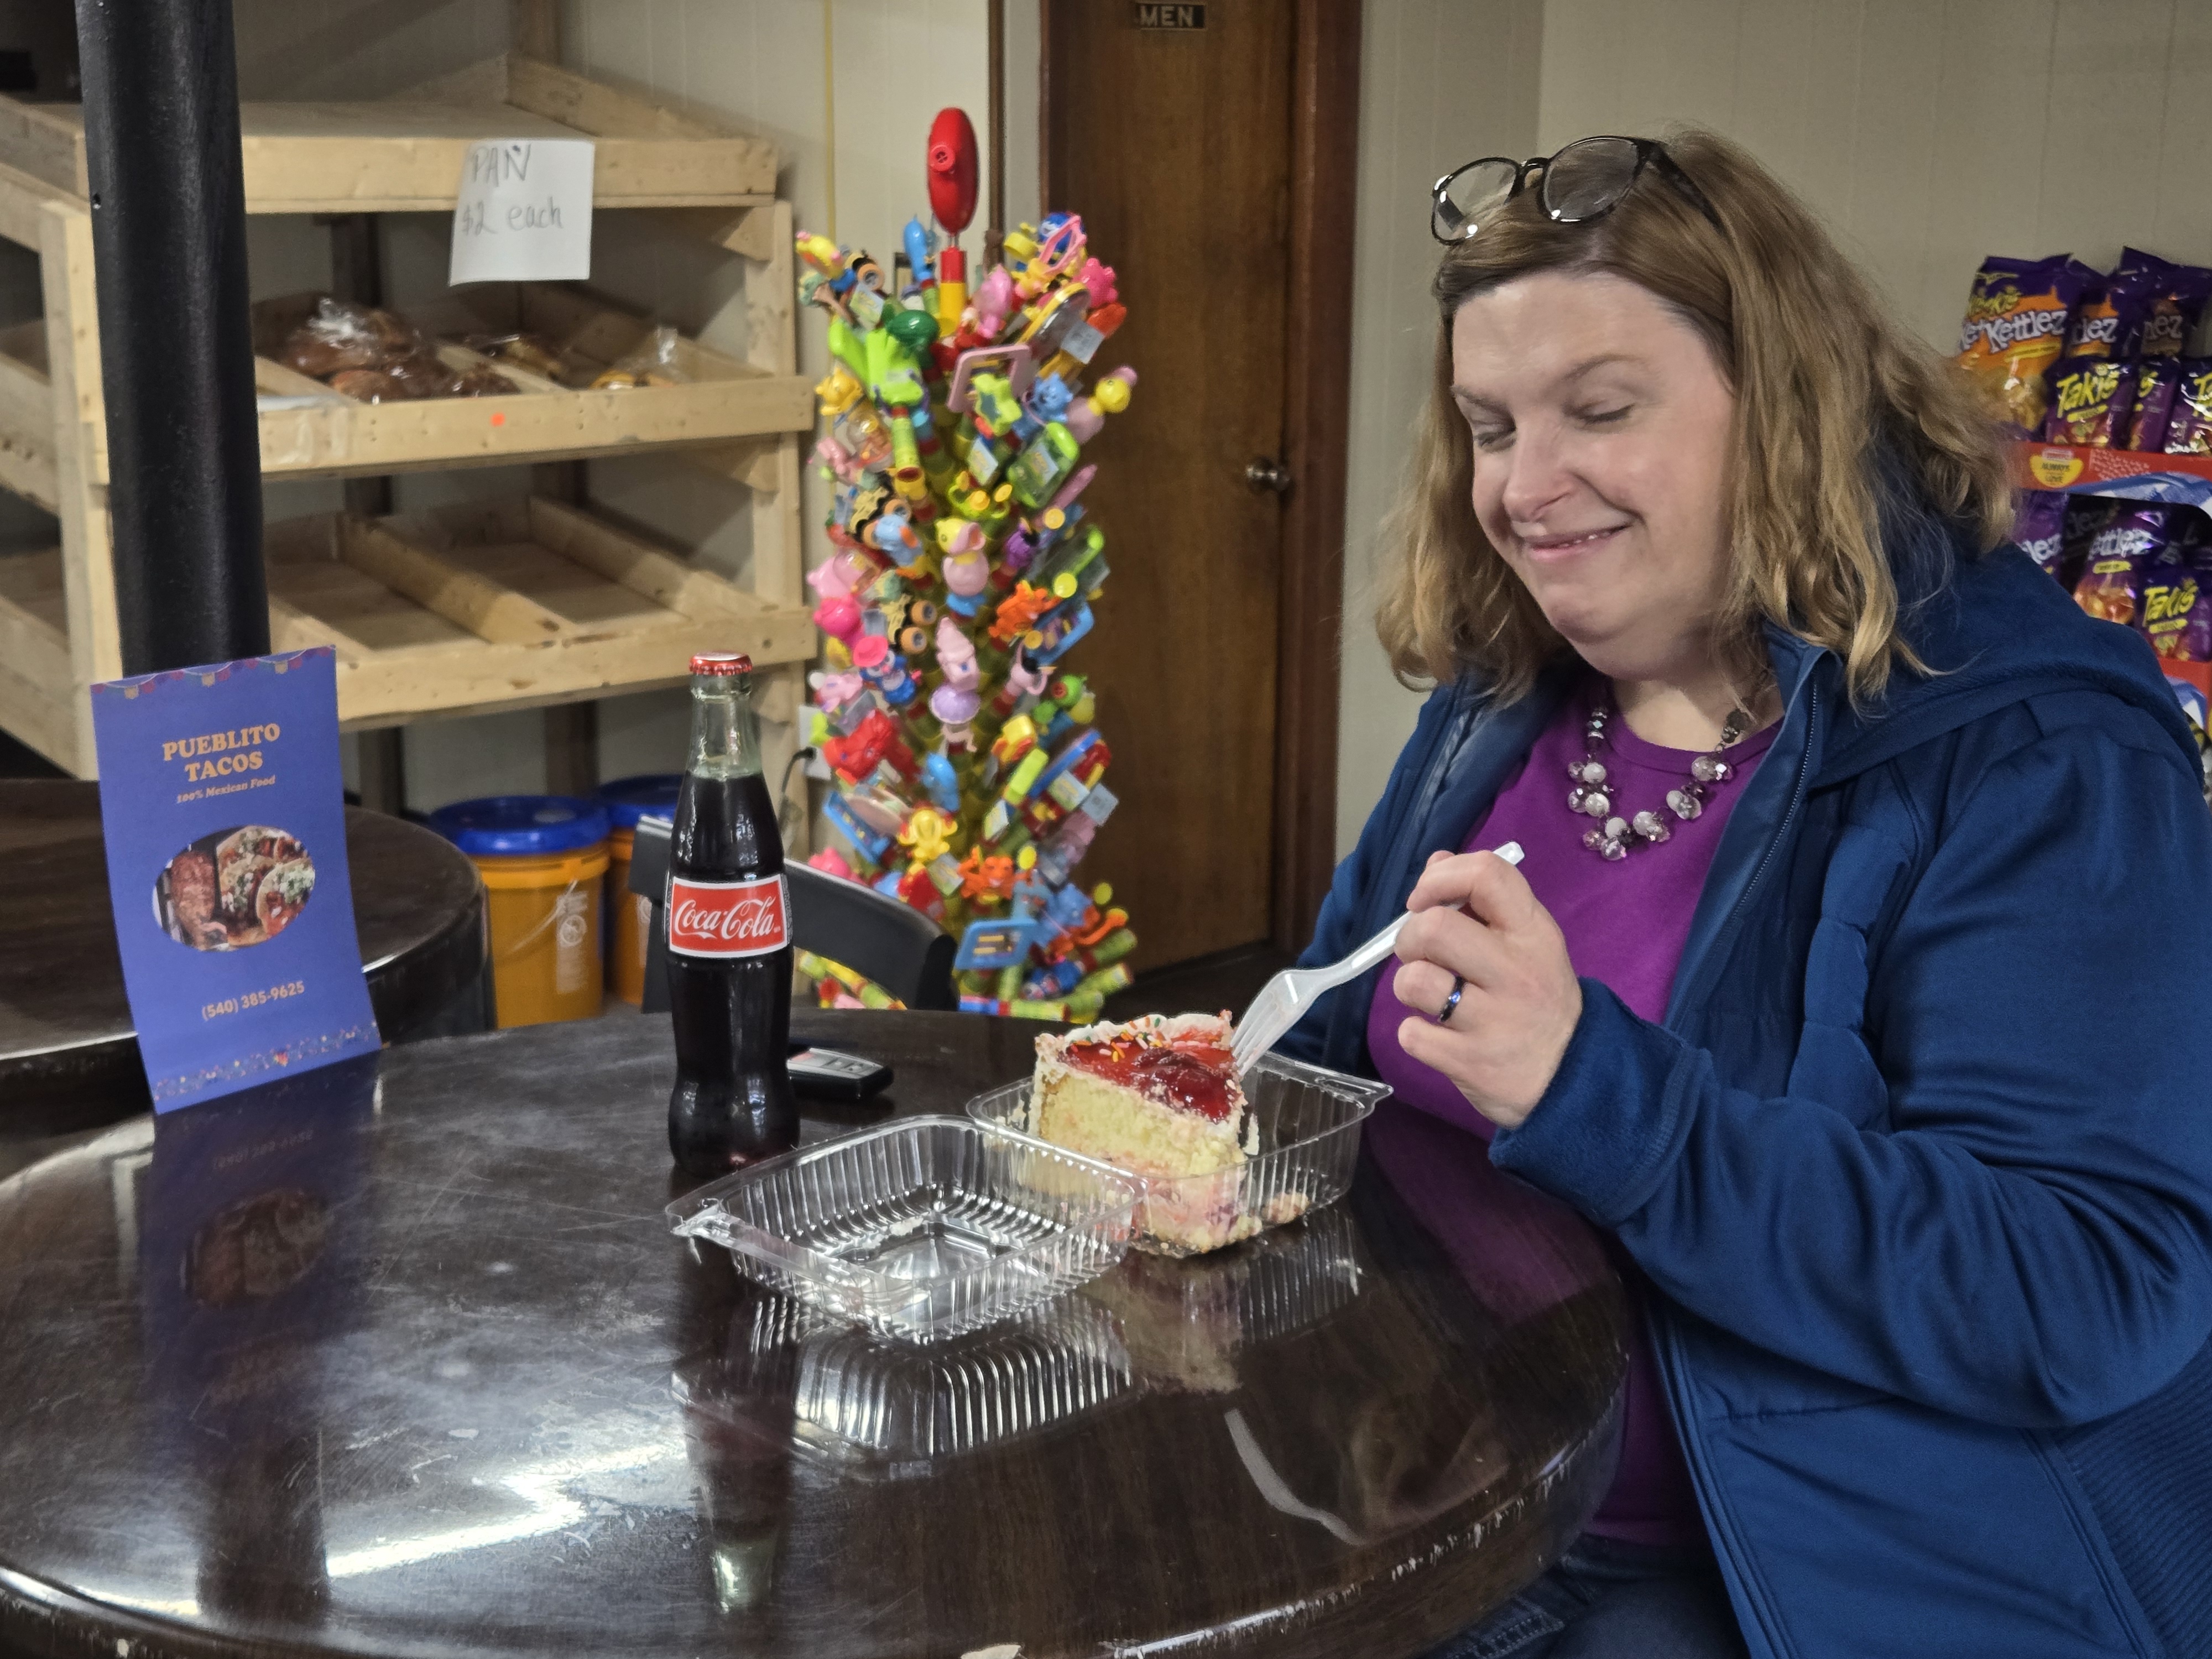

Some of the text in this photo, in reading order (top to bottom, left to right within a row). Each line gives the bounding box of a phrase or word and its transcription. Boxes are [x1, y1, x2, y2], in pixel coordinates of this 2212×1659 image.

[1140, 6, 1193, 27] MEN
[471, 144, 531, 187] PAN
[463, 196, 564, 236] $2 each
[2056, 362, 2119, 419] Takis
[162, 723, 280, 761] PUEBLITO
[184, 751, 263, 782] TACOS
[176, 774, 276, 804] 100% Mexican Food
[675, 896, 776, 940] Coca-Cola
[201, 980, 305, 1022] (540) 385-9625
